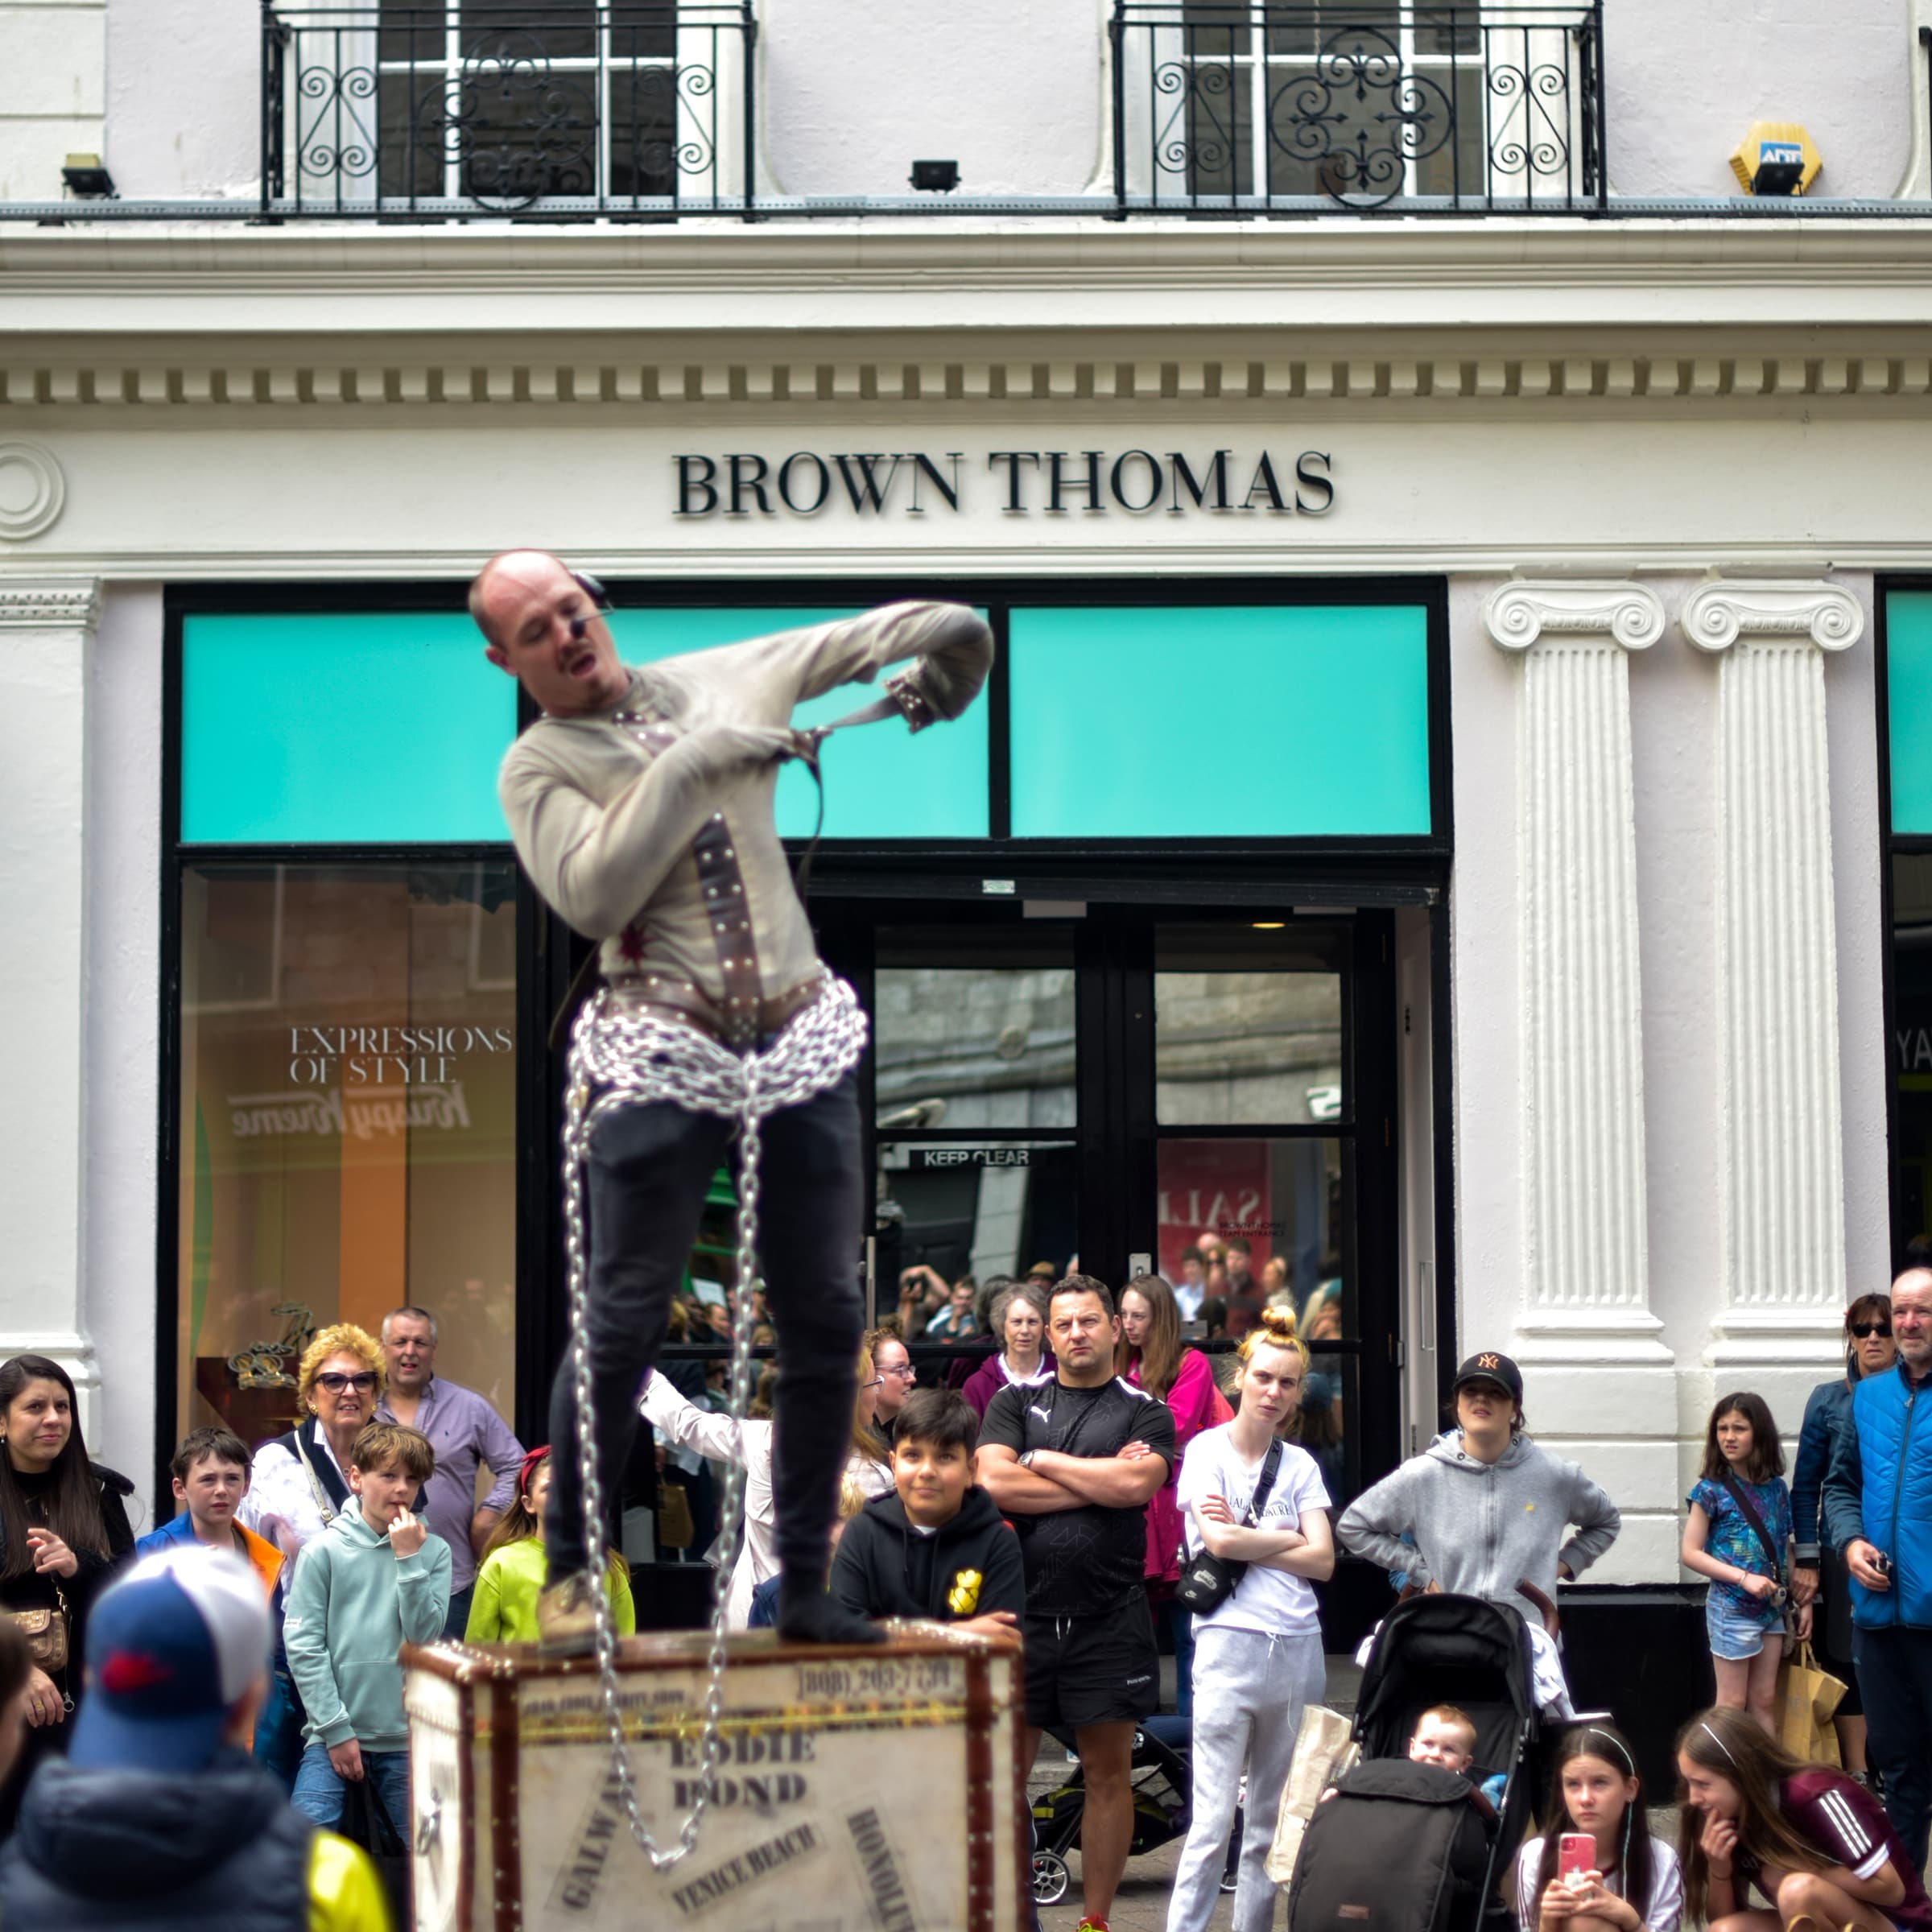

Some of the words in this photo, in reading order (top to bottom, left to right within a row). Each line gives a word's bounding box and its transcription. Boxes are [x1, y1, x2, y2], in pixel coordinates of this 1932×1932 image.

[671, 452, 964, 515] BROWN
[989, 449, 1335, 514] THOMAS
[291, 1026, 513, 1054] EXPRESSIONS
[1896, 1027, 1932, 1070] YA
[289, 1057, 337, 1084] OF
[349, 1057, 457, 1084] STYLE
[924, 1151, 968, 1166] KEEP
[674, 1773, 807, 1810] BOND
[671, 1863, 749, 1915] VENICE
[748, 1823, 817, 1876] BEACH
